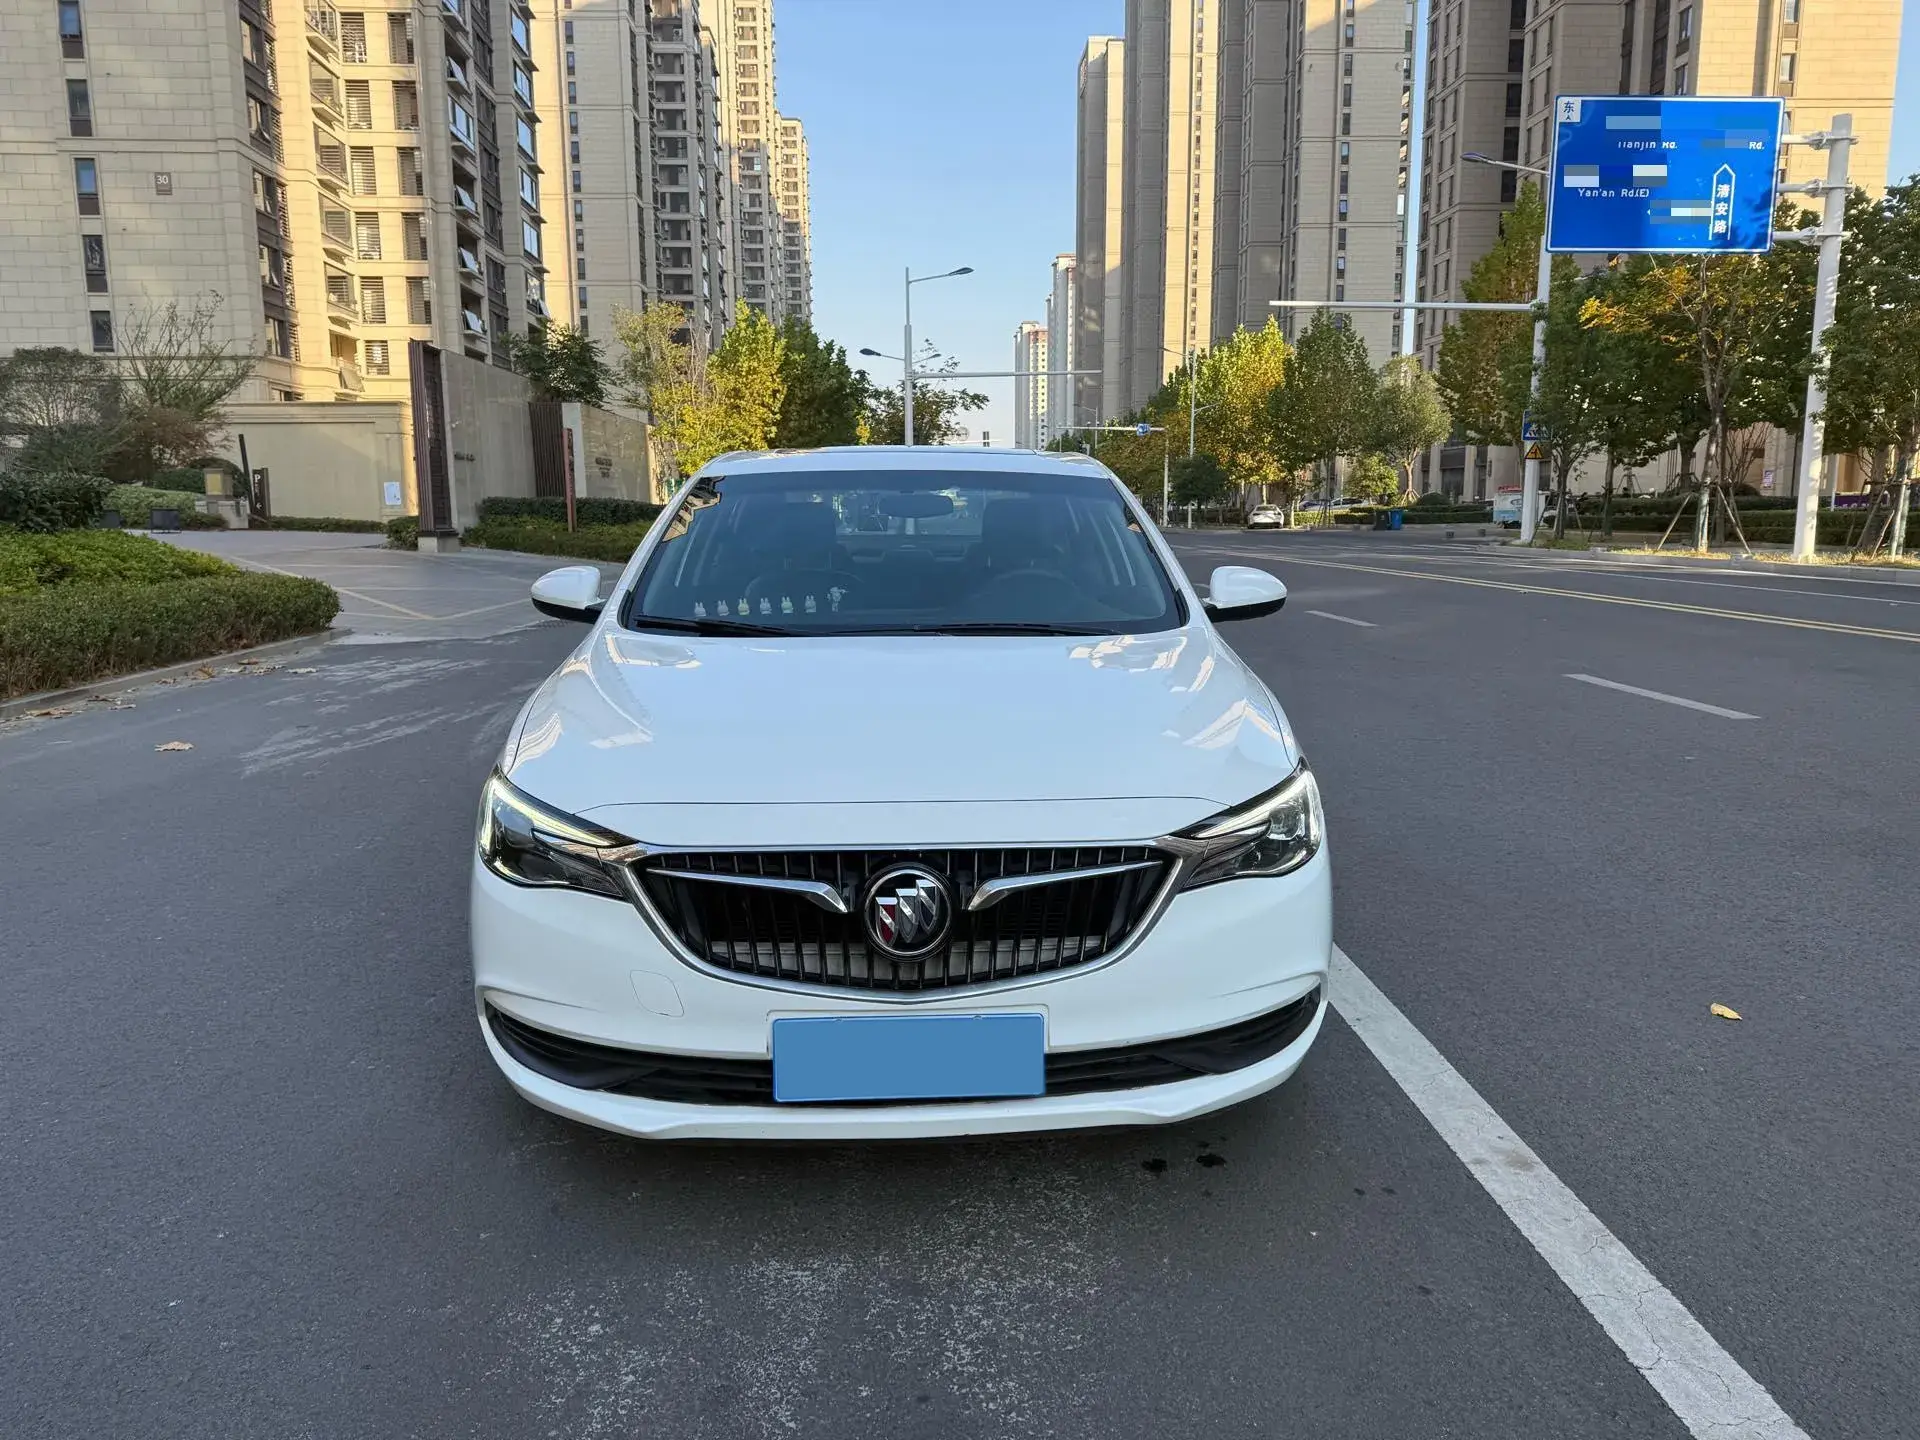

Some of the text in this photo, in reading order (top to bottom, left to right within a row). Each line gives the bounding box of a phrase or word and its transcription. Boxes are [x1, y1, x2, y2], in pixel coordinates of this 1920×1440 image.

[1563, 100, 1575, 113] 东
[156, 175, 168, 184] 30
[1578, 188, 1615, 197] Yan'an
[254, 474, 261, 483] P
